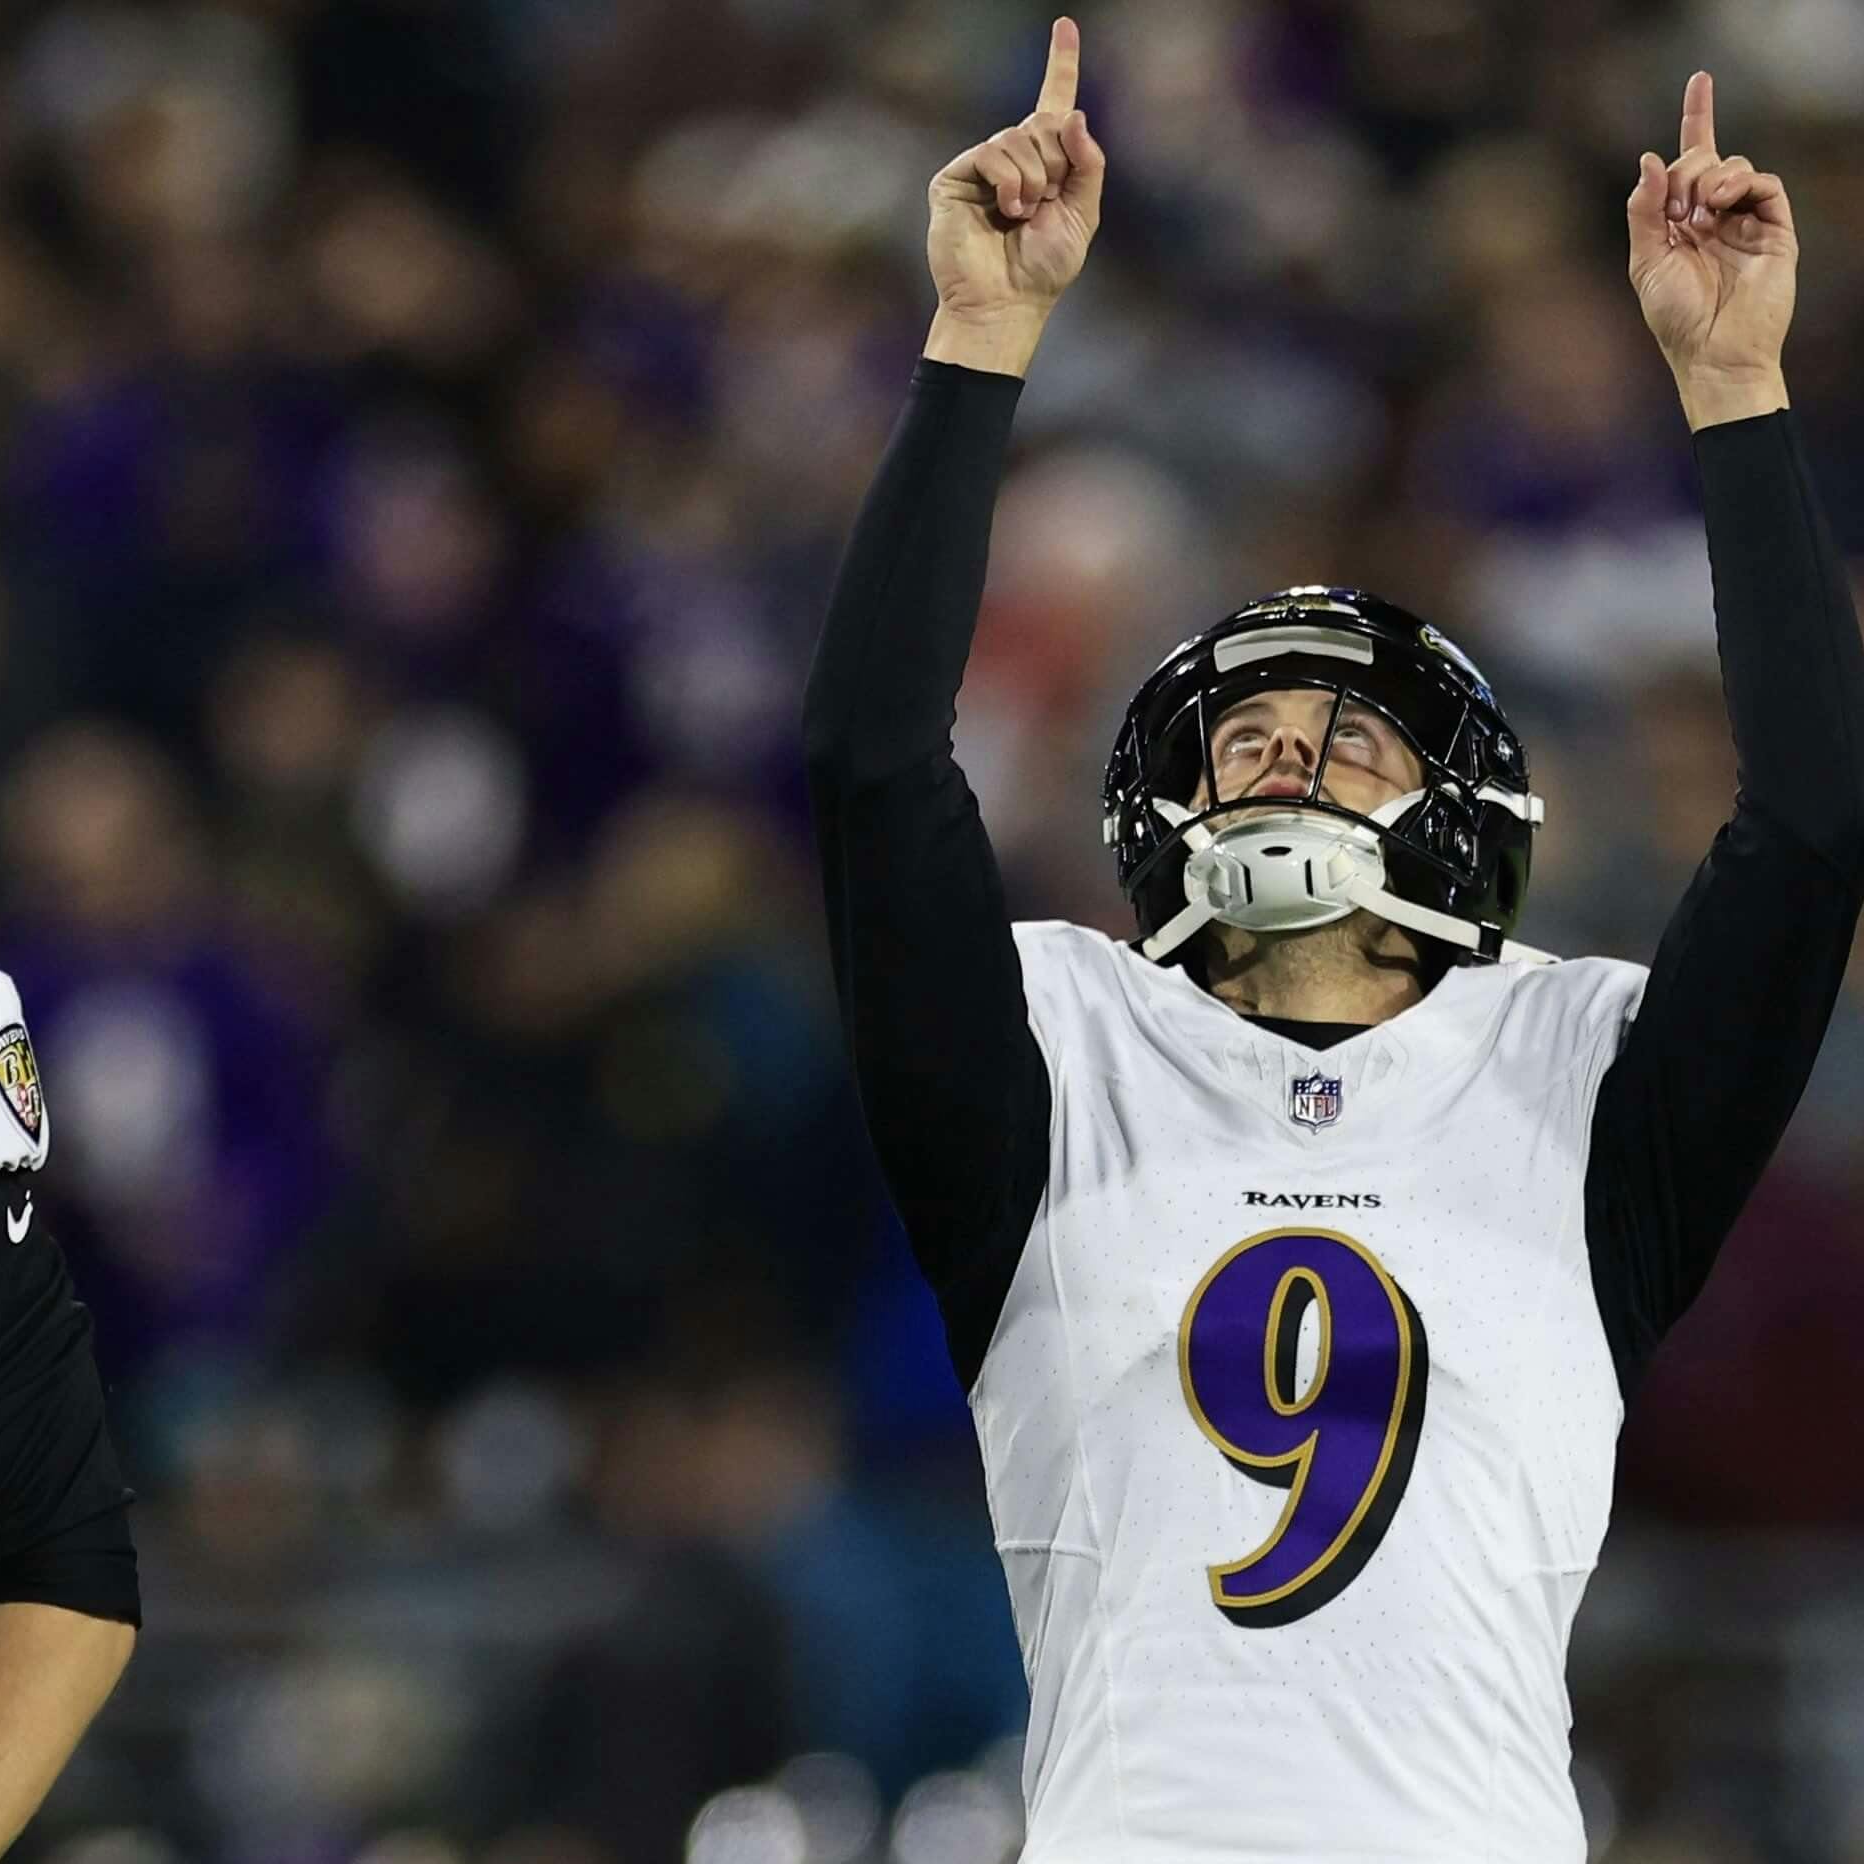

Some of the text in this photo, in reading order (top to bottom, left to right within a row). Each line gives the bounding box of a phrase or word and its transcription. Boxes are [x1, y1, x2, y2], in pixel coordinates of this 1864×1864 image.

[1298, 1095, 1335, 1120] NFL
[1241, 1191, 1384, 1211] RAVENS
[1177, 1226, 1430, 1630] 9
